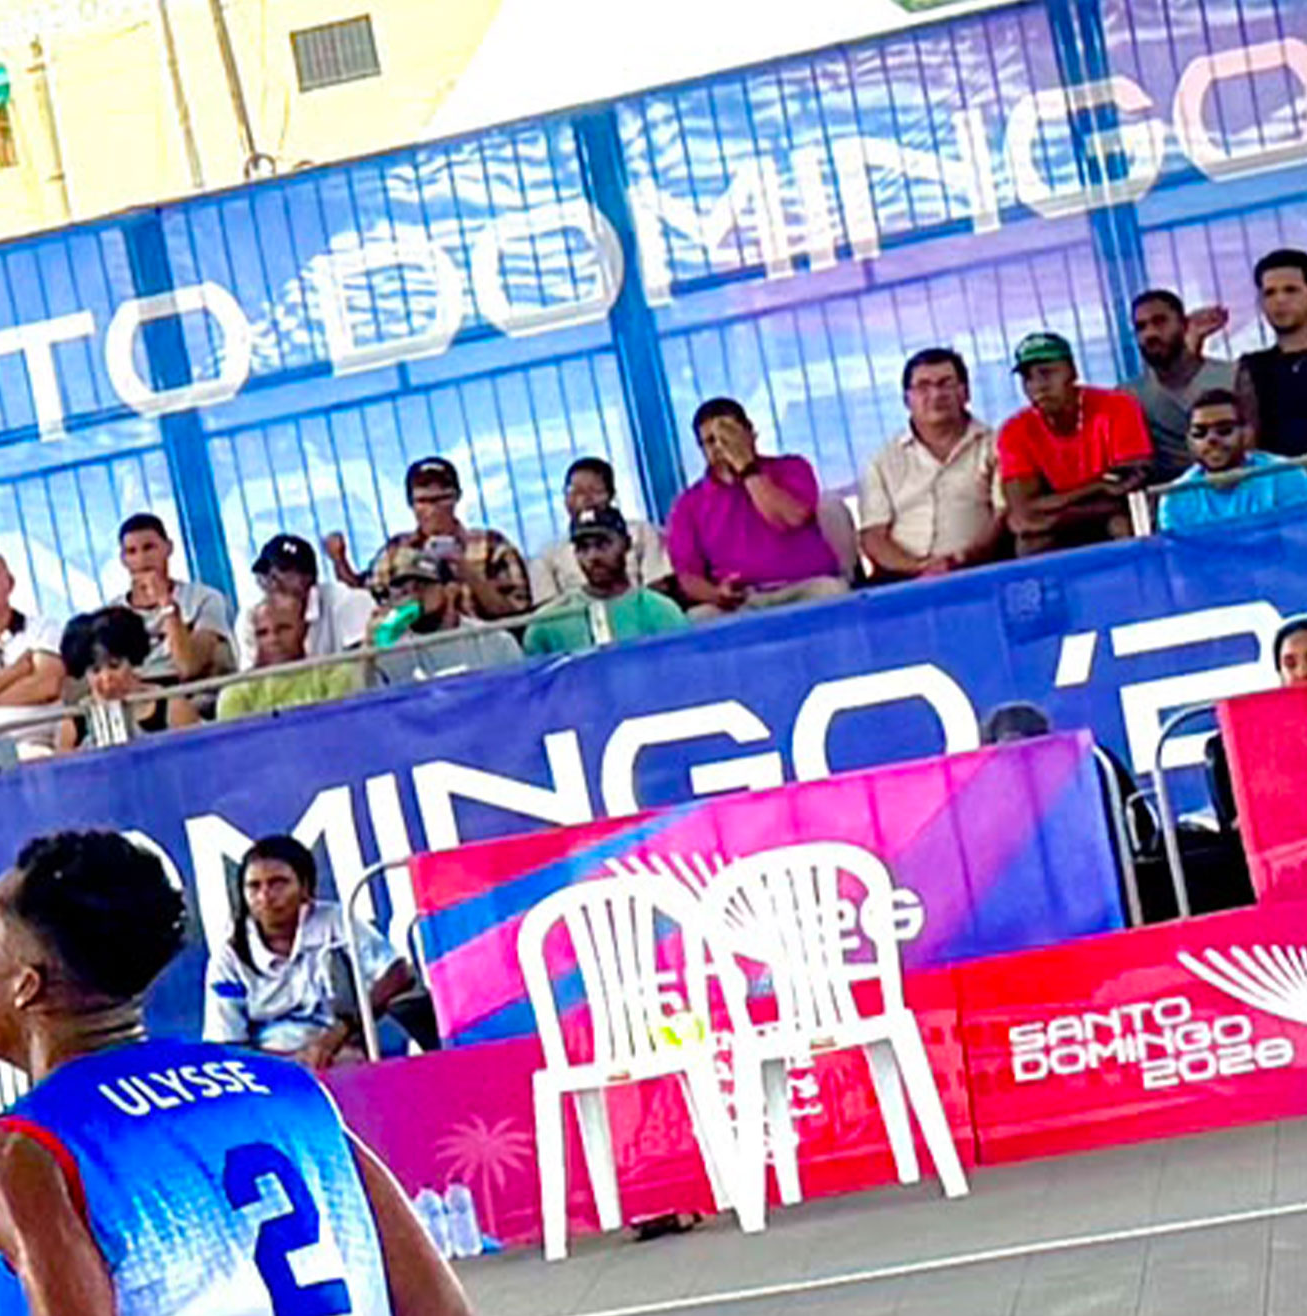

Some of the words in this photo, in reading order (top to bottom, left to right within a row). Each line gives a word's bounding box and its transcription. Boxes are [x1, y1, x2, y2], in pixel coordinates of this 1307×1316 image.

[311, 36, 1307, 377] DOMINGO
[1008, 995, 1192, 1052] SANTO
[1011, 1014, 1253, 1083] DOMINGO
[96, 1059, 271, 1119] ULYSSE
